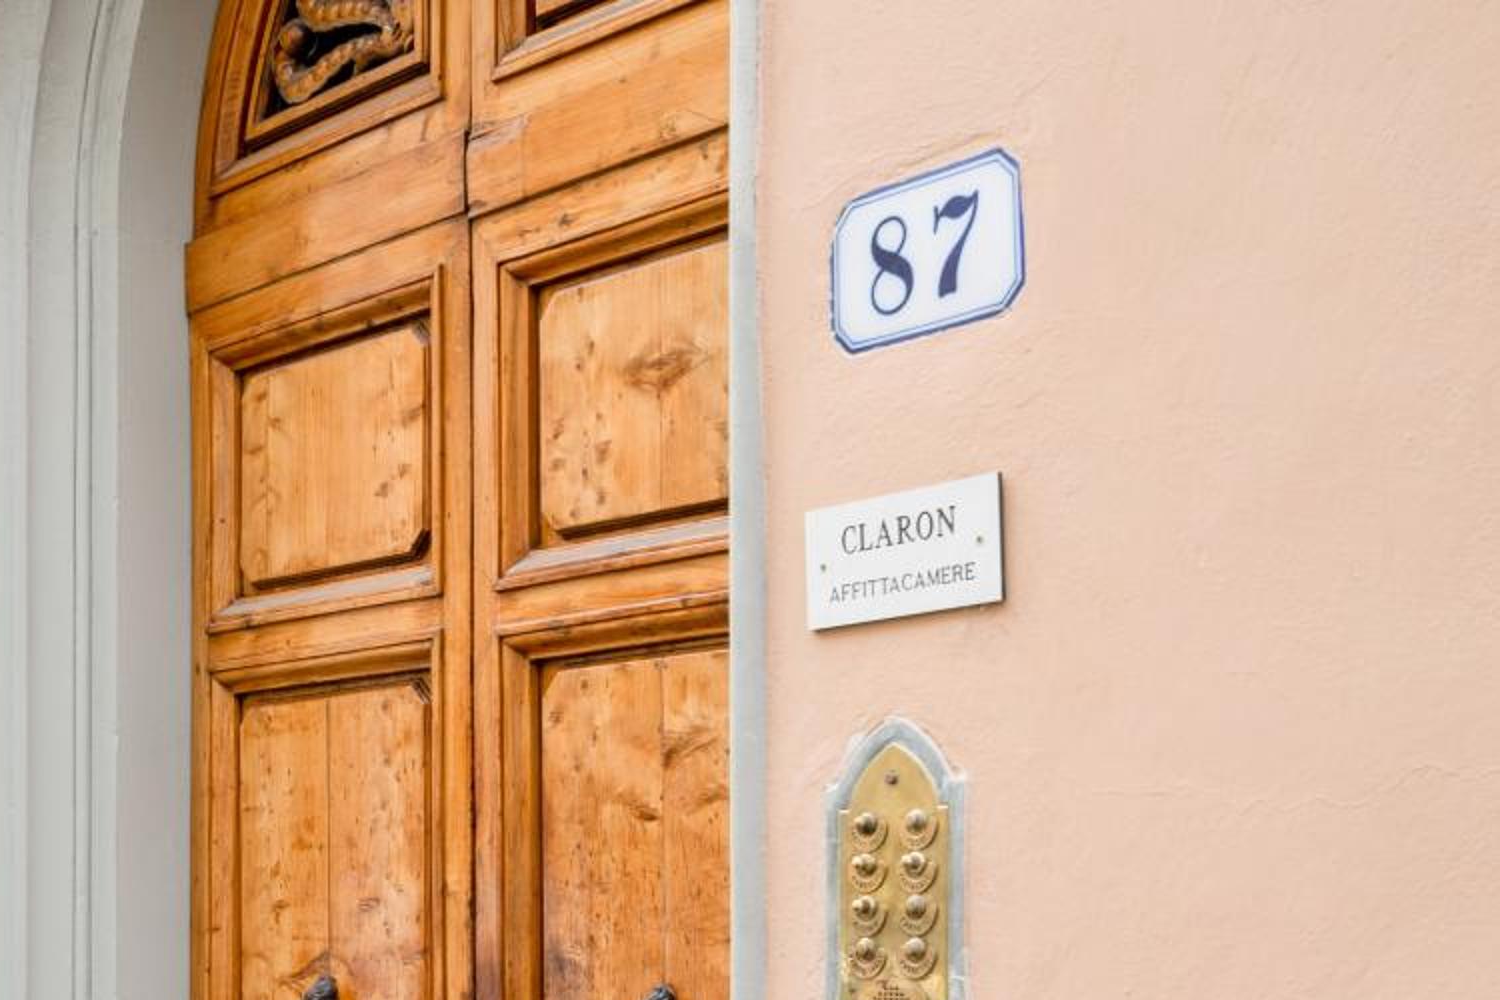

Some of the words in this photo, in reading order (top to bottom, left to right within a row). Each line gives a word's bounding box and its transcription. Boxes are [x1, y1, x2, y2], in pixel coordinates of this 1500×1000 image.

[870, 189, 980, 316] 87
[841, 504, 956, 555] CLARON
[829, 561, 977, 604] AFFITTACAMERE
